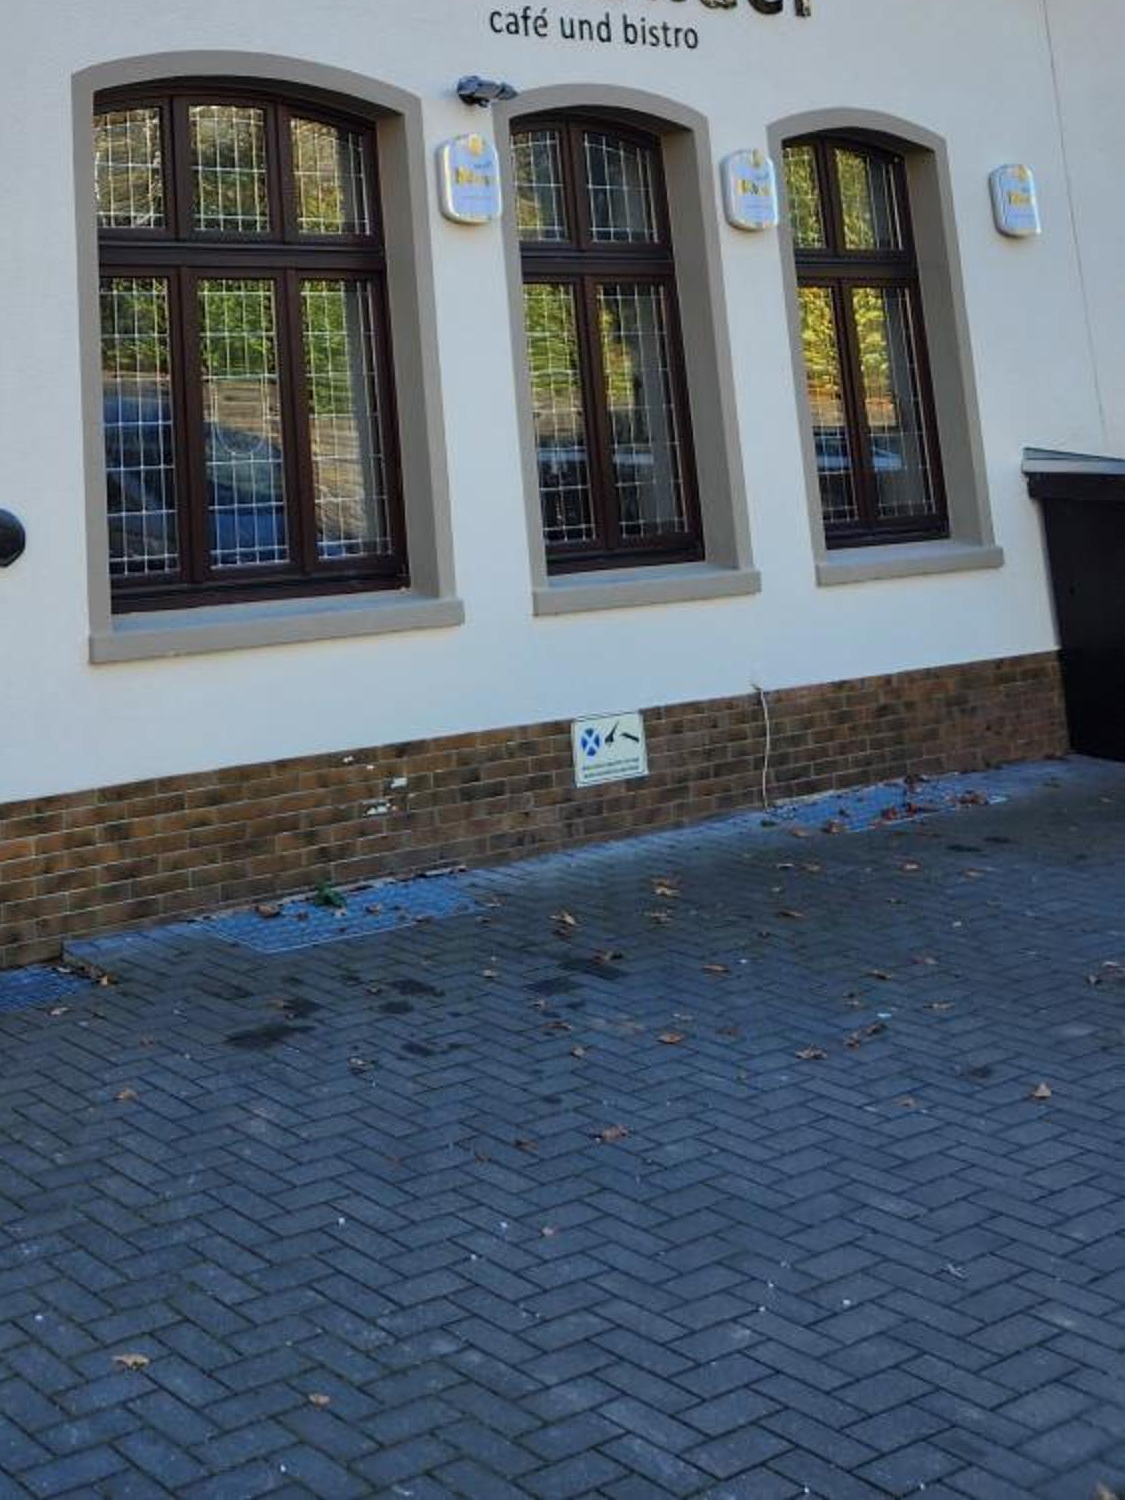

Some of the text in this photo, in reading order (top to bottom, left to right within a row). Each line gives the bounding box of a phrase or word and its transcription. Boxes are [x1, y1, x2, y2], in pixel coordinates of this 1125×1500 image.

[489, 6, 699, 49] café und bistro
